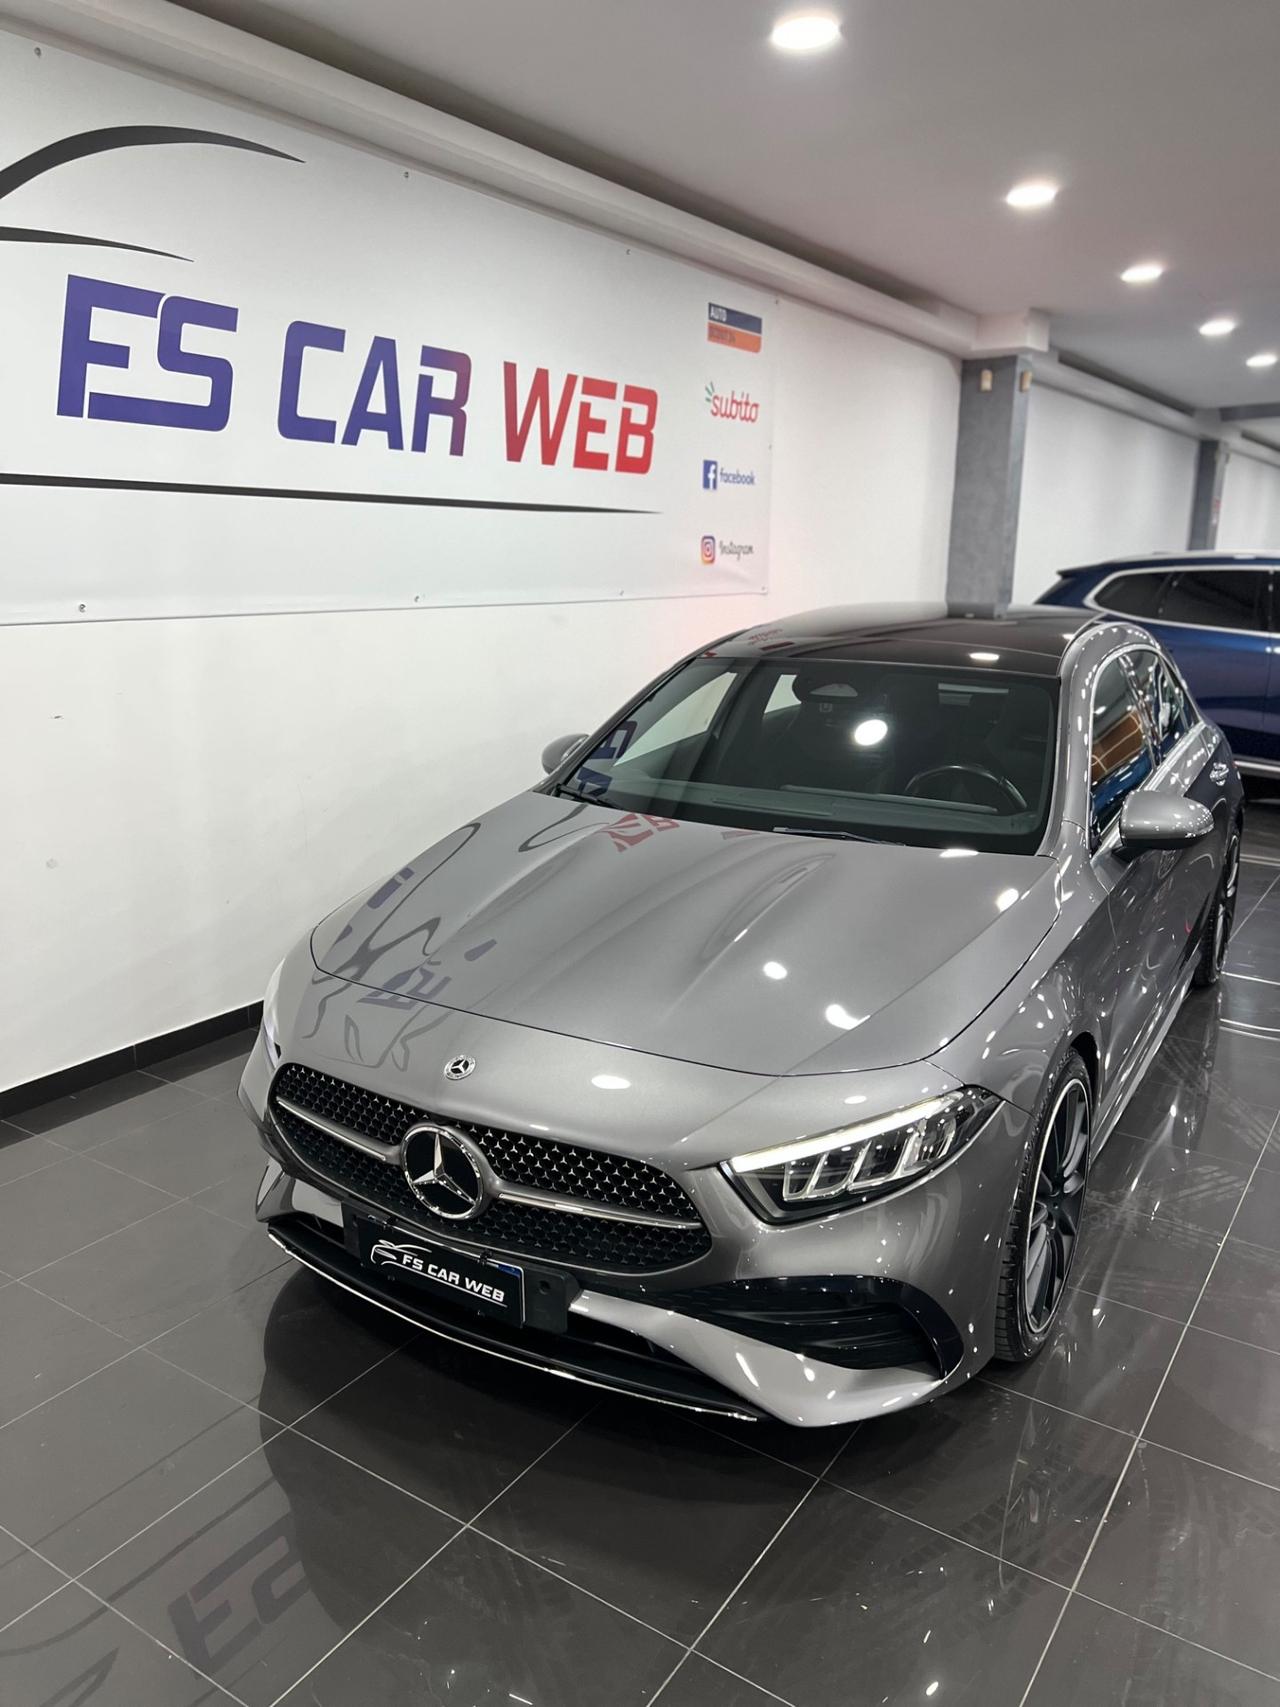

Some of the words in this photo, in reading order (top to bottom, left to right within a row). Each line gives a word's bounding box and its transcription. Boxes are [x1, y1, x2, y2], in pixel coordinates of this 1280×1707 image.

[277, 321, 472, 457] CAR
[503, 361, 659, 475] WEB
[711, 390, 759, 423] subito
[720, 467, 755, 485] facebook
[402, 1254, 424, 1271] FS
[427, 1263, 460, 1285] CAR
[465, 1277, 505, 1302] WEB
